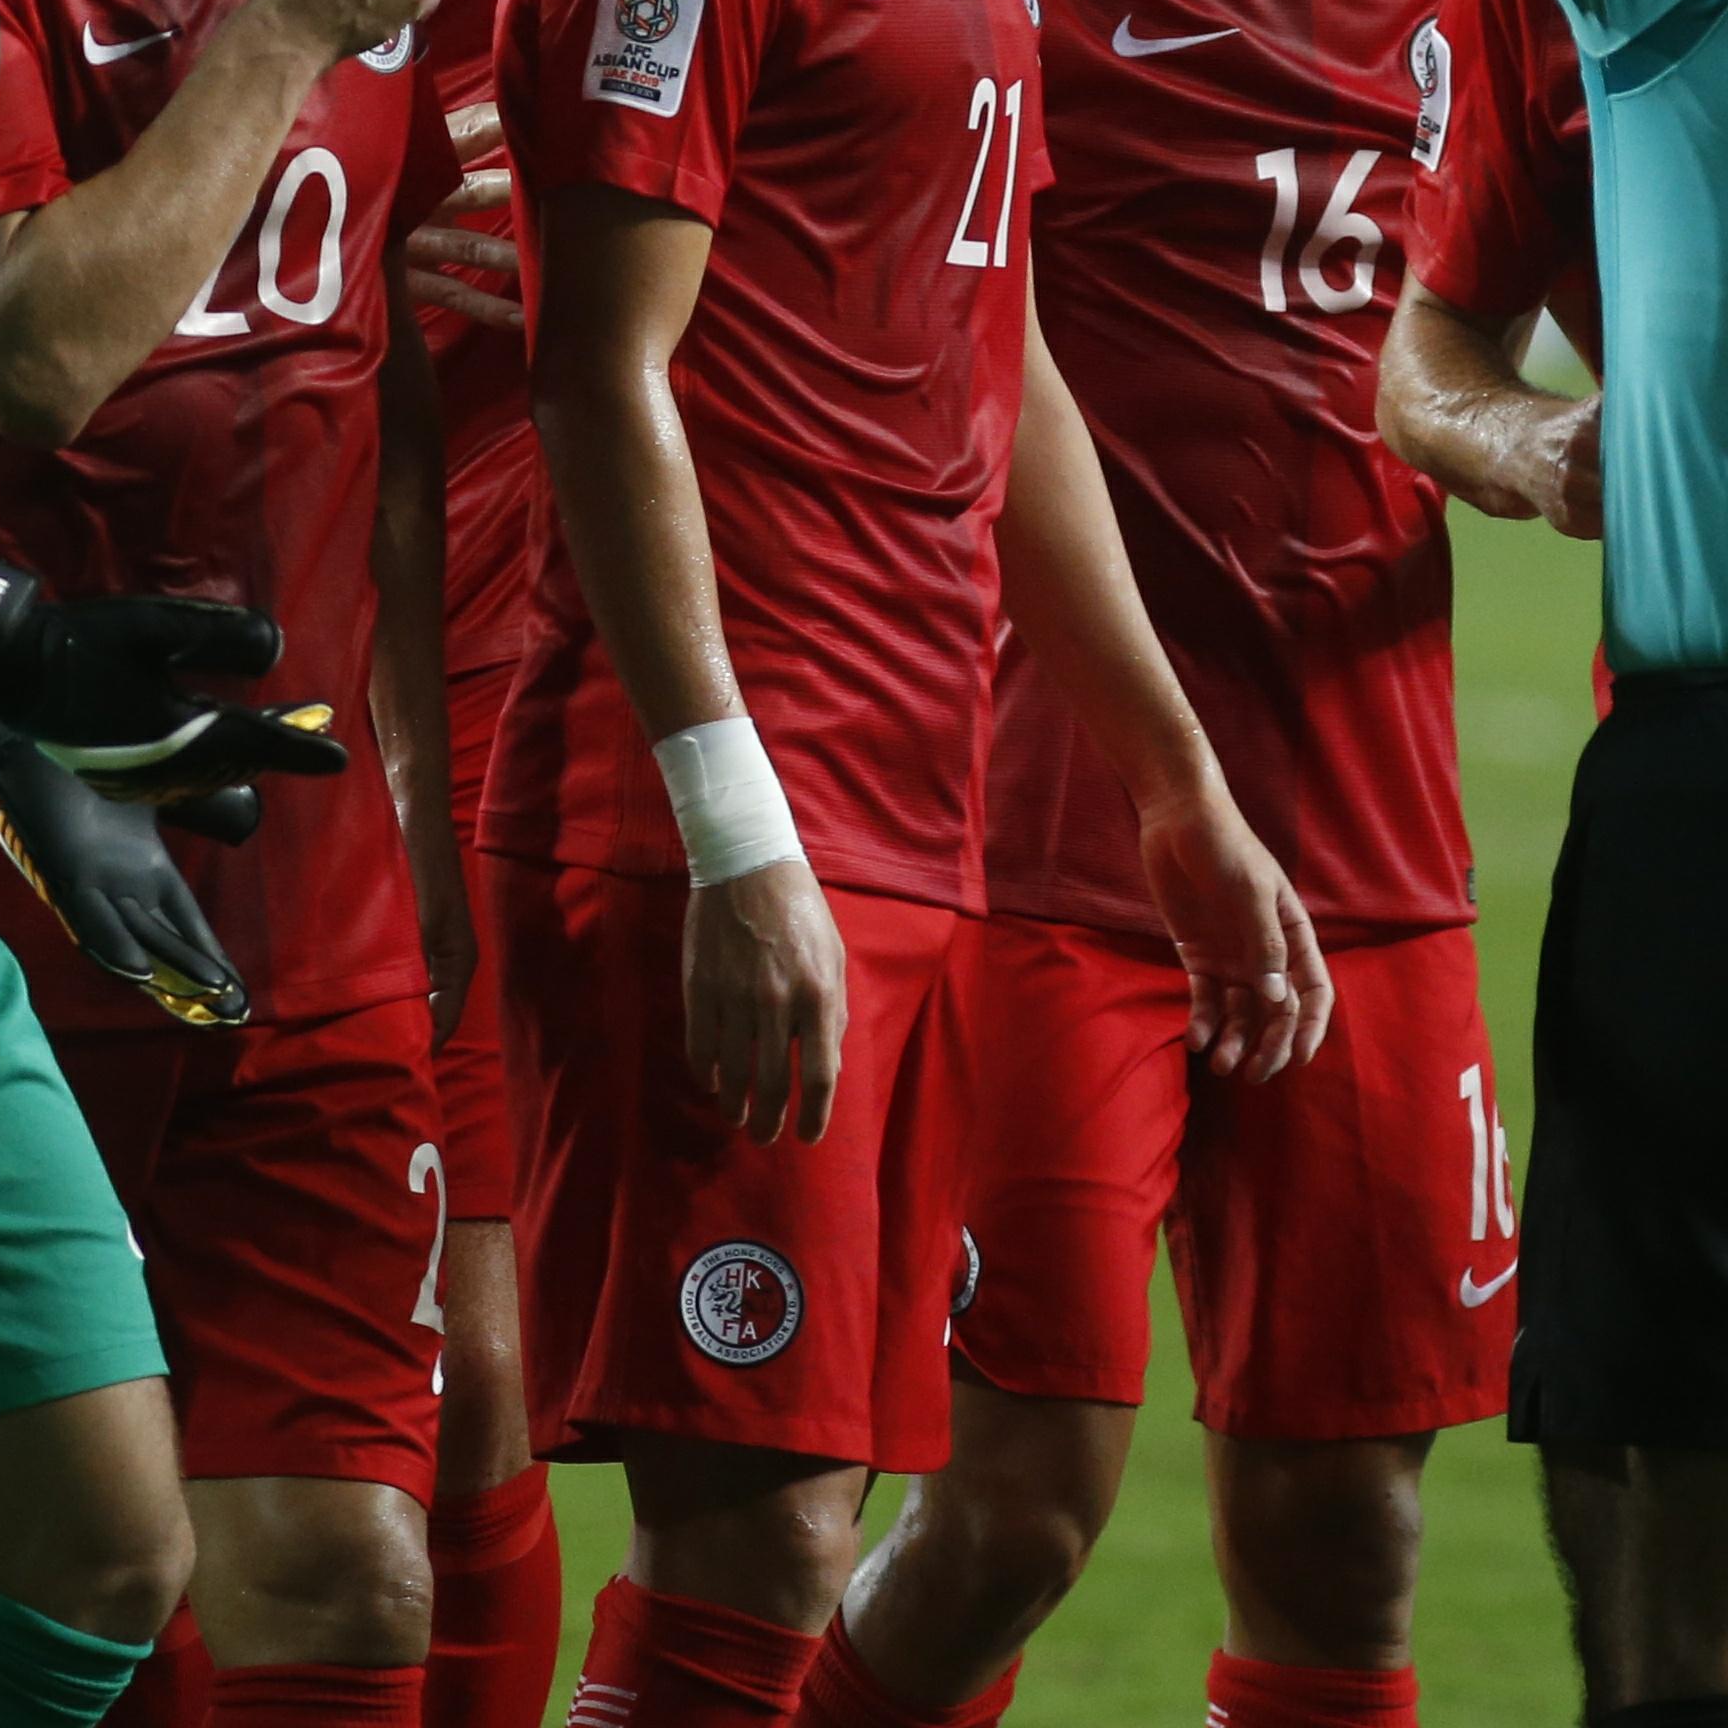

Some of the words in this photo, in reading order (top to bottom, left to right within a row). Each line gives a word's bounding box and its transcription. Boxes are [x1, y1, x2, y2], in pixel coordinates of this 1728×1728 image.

[592, 52, 642, 72] ASIAN
[645, 60, 680, 81] CUP
[623, 42, 653, 59] AFC
[631, 71, 660, 88] 2019
[944, 77, 1022, 270] 21
[1254, 148, 1385, 314] 16
[408, 1142, 447, 1336] 2
[702, 1252, 722, 1269] THE
[724, 1248, 756, 1258] HONG
[759, 1252, 786, 1275] KONG
[685, 1290, 713, 1349] FOOTBALL
[716, 1326, 790, 1359] ASSOCIATION
